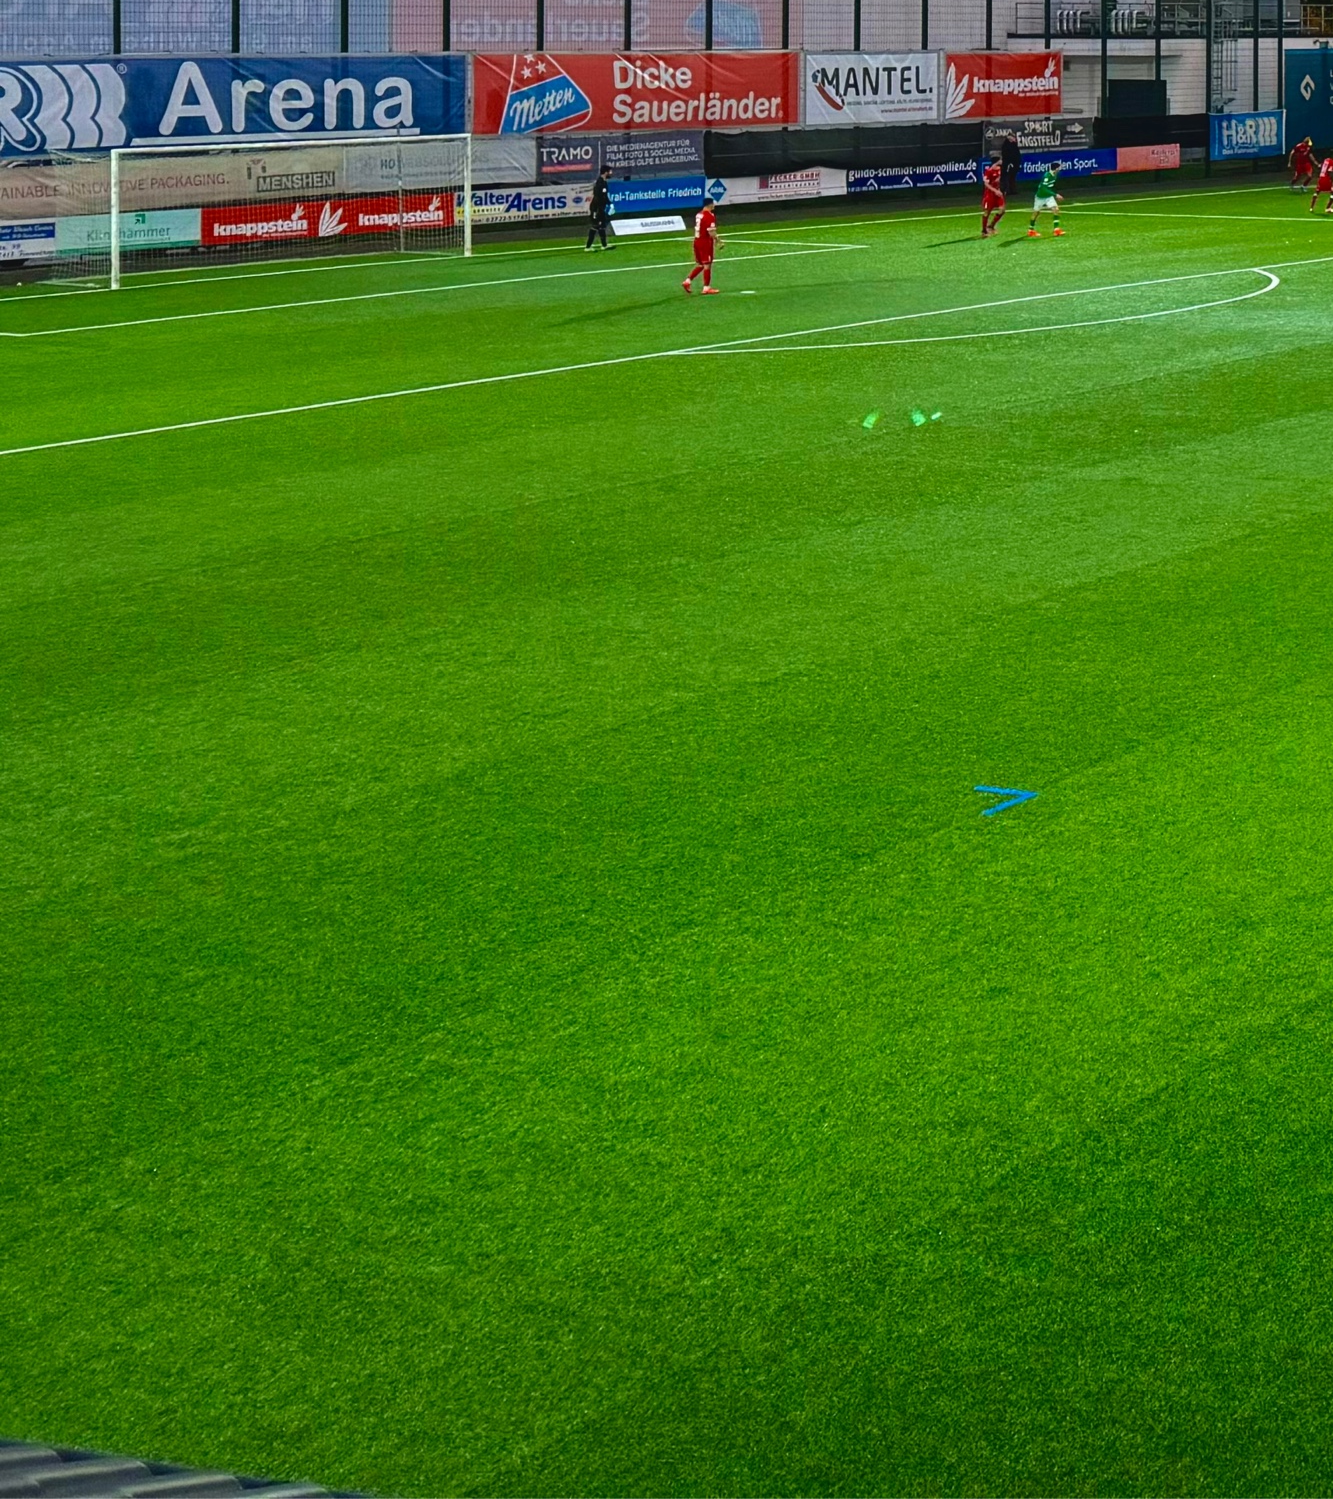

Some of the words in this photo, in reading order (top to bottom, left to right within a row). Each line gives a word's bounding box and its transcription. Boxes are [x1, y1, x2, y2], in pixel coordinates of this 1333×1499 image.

[613, 61, 692, 90] Dicke
[973, 74, 1059, 95] knappstein
[158, 61, 415, 136] Arena
[510, 85, 576, 133] Metten
[541, 145, 592, 162] TRAMO
[258, 174, 333, 191] MENSHEN
[668, 186, 702, 198] Friedrich
[503, 193, 568, 213] Arens
[213, 218, 308, 238] knappstein
[359, 210, 444, 227] knappstein
